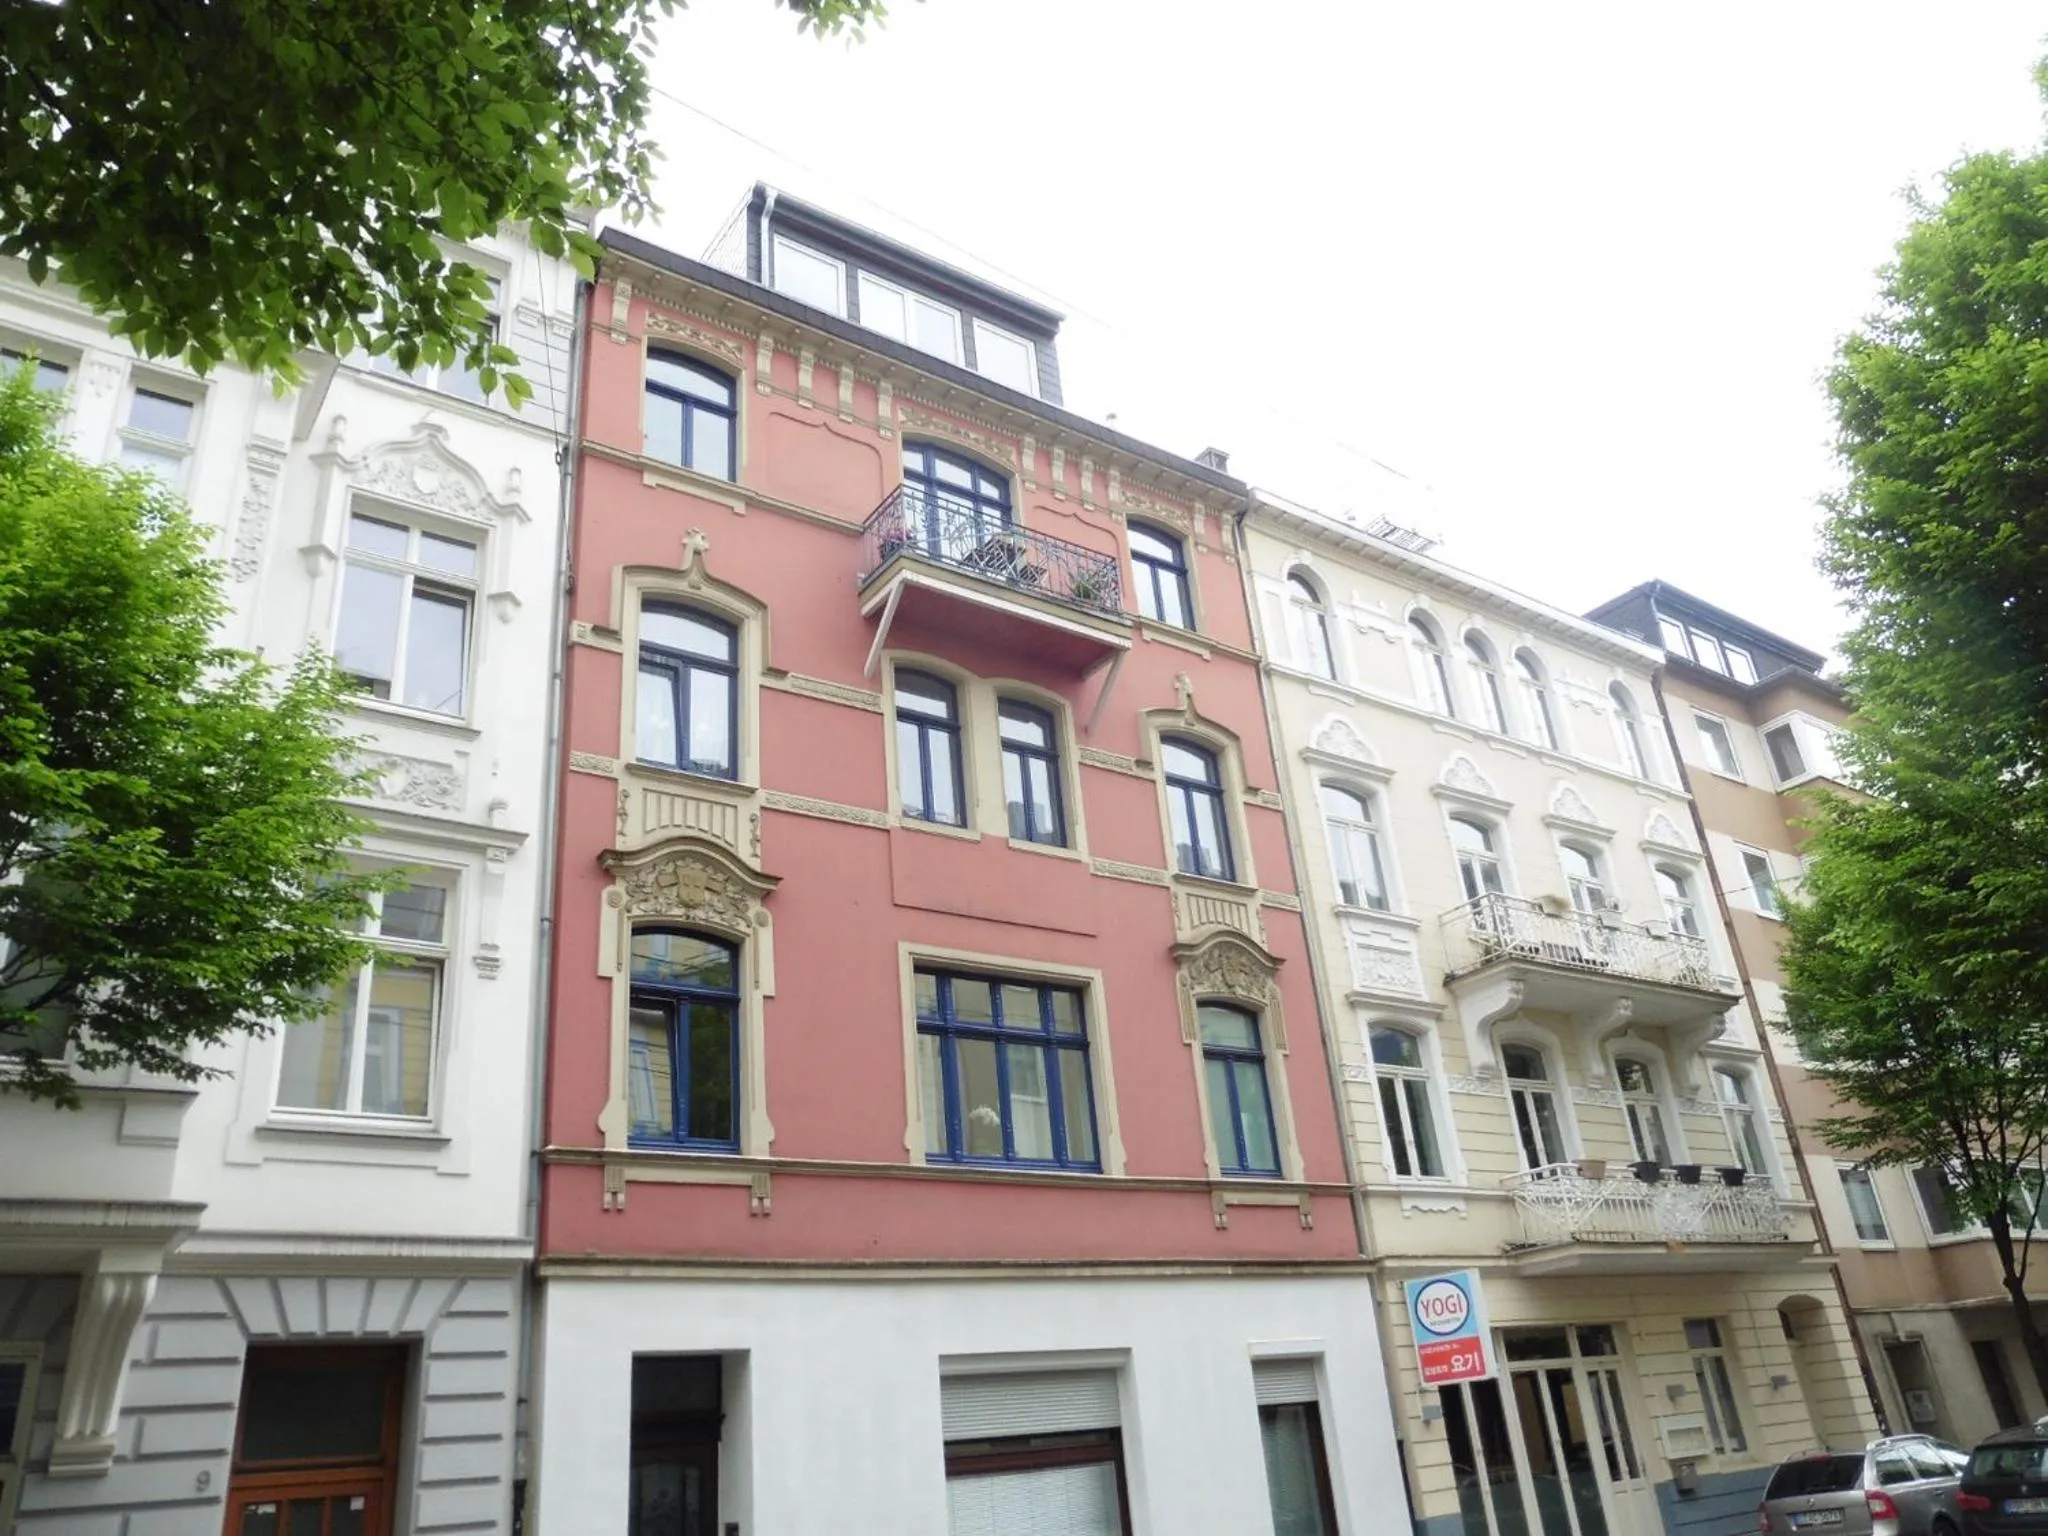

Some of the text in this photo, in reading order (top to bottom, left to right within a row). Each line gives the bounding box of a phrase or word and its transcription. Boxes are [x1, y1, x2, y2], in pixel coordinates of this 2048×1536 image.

[1421, 1293, 1463, 1318] YOGI
[1451, 1352, 1481, 1373] 요기
[196, 1470, 211, 1493] 9
